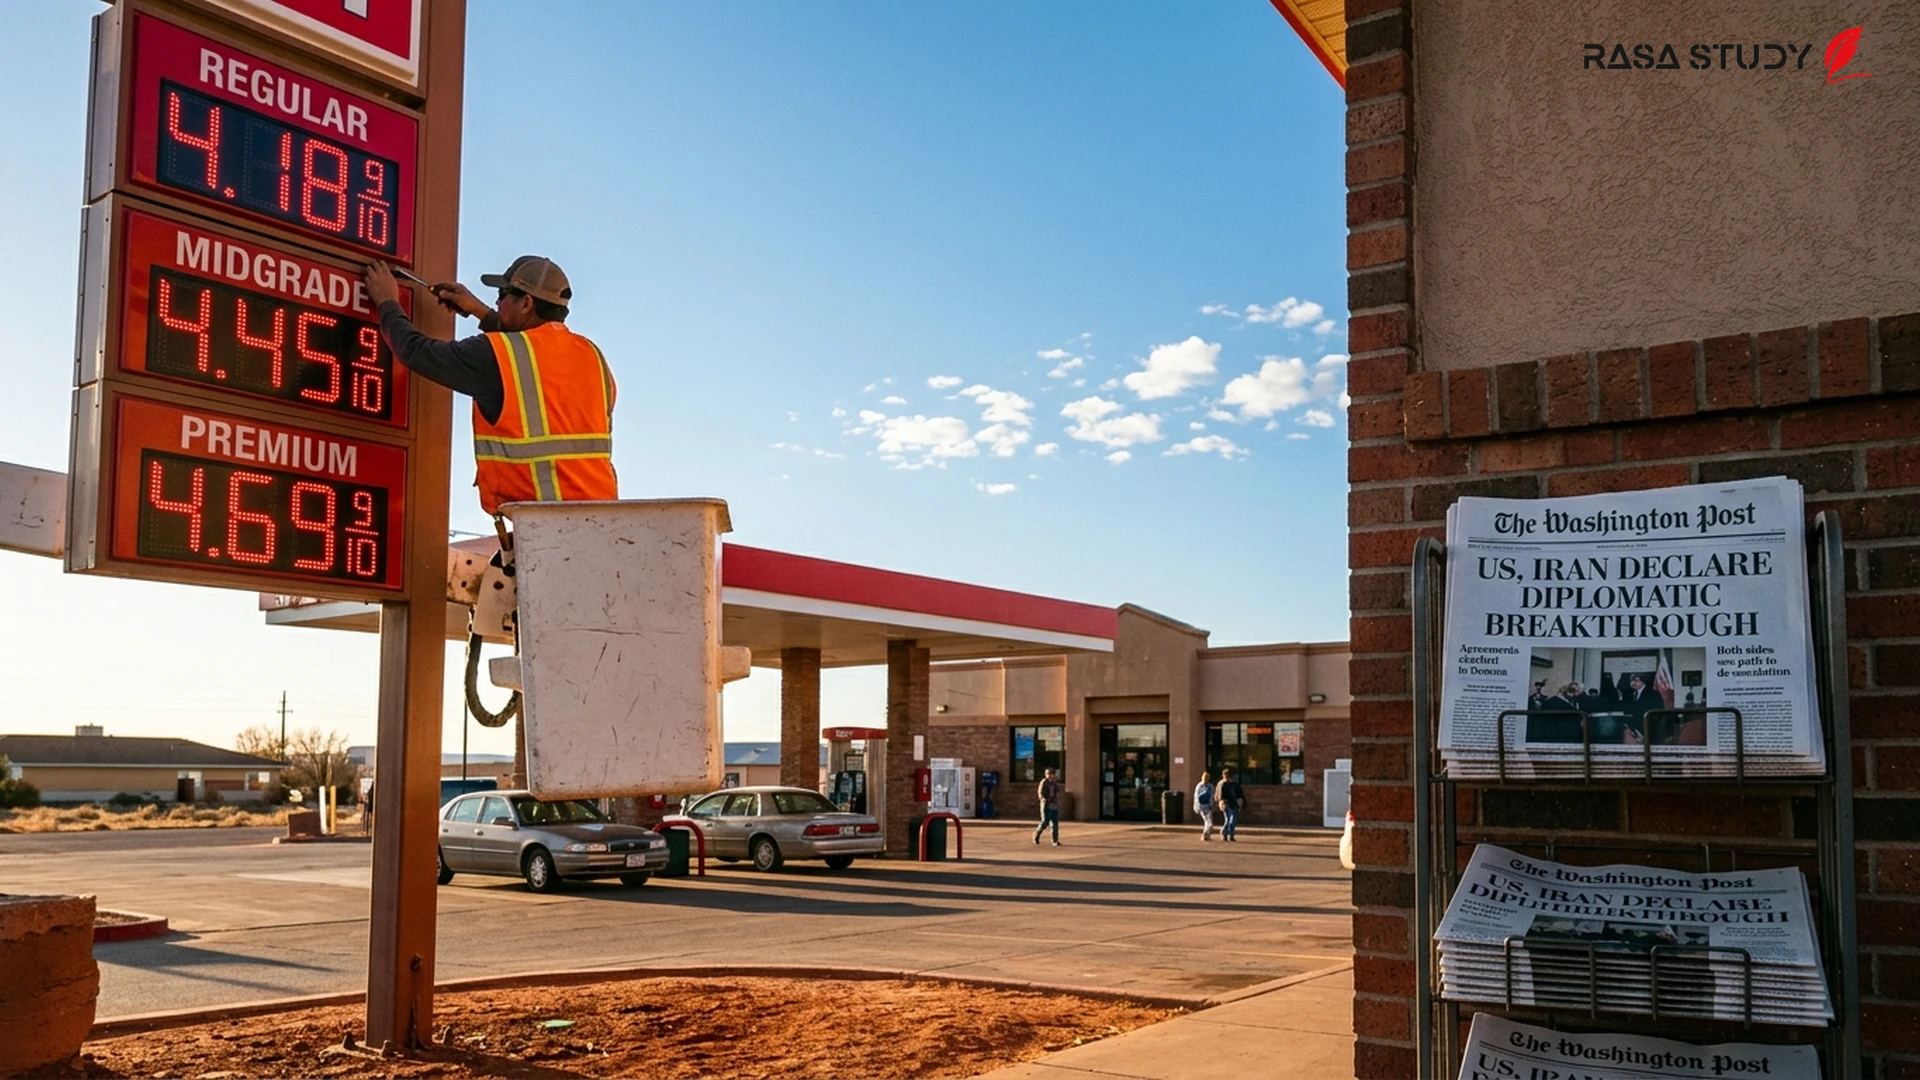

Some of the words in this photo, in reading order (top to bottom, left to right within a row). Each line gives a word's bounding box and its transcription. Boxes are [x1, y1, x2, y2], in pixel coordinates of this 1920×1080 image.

[199, 47, 369, 142] REGULAR
[167, 91, 349, 233] 4.18
[175, 230, 372, 315] MIDGRADE
[158, 279, 341, 403] 4.45
[180, 414, 358, 478] PREMIUM
[149, 460, 337, 571] 4.69
[1494, 511, 1538, 538] The
[1543, 505, 1690, 535] Washington
[1696, 502, 1757, 533] Post
[1477, 556, 1525, 584] US,
[1532, 557, 1610, 581] IRAN
[1617, 551, 1773, 580] DECLARE
[1519, 582, 1722, 610] DIPLOMATIC
[1484, 611, 1760, 638] BREAKTHROUGH
[1555, 868, 1692, 888] Washington
[1699, 876, 1755, 891] Post
[1556, 1038, 1704, 1069] Washington
[1711, 1055, 1771, 1076] Post
